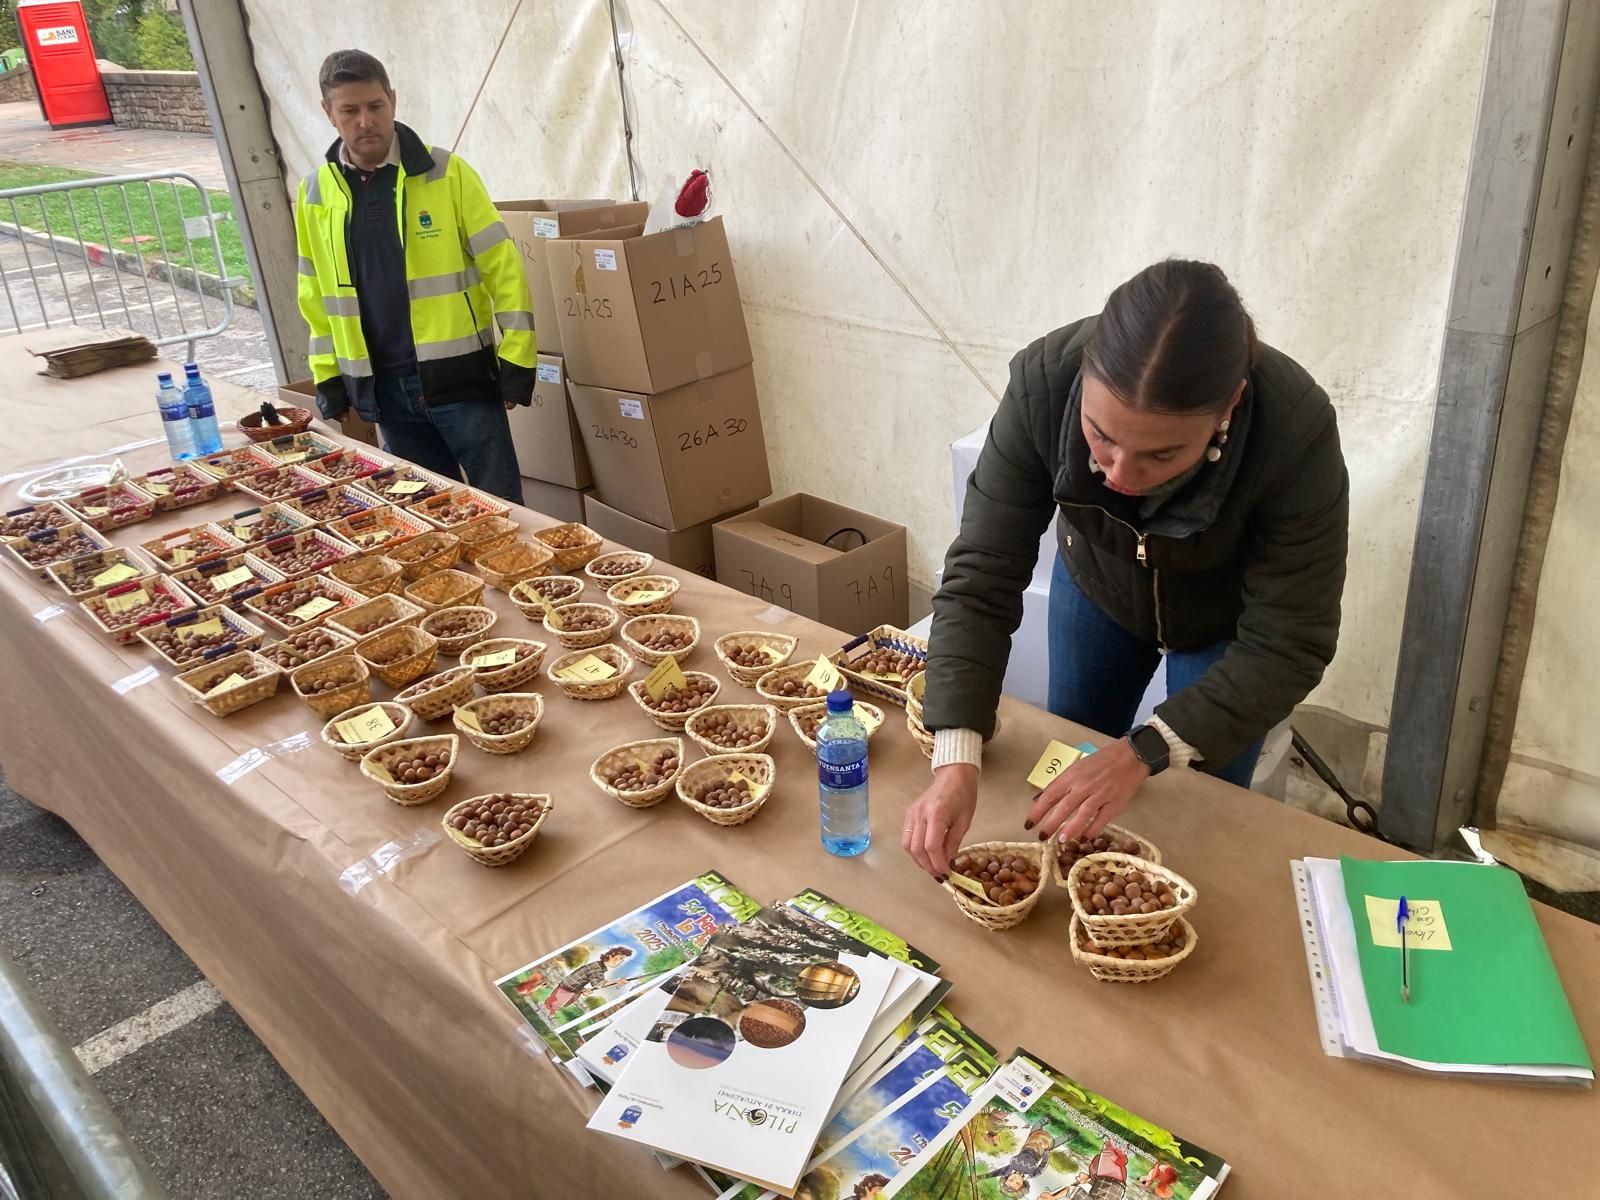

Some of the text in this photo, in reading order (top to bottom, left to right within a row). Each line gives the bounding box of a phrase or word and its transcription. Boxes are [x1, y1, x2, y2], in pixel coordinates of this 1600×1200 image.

[632, 928, 669, 952] 2025
[923, 1029, 964, 1064] El
[945, 1059, 988, 1097] El
[717, 1090, 763, 1106] ASTURCONES
[773, 1105, 803, 1117] TIERRA
[713, 1099, 798, 1134] PILOÑA
